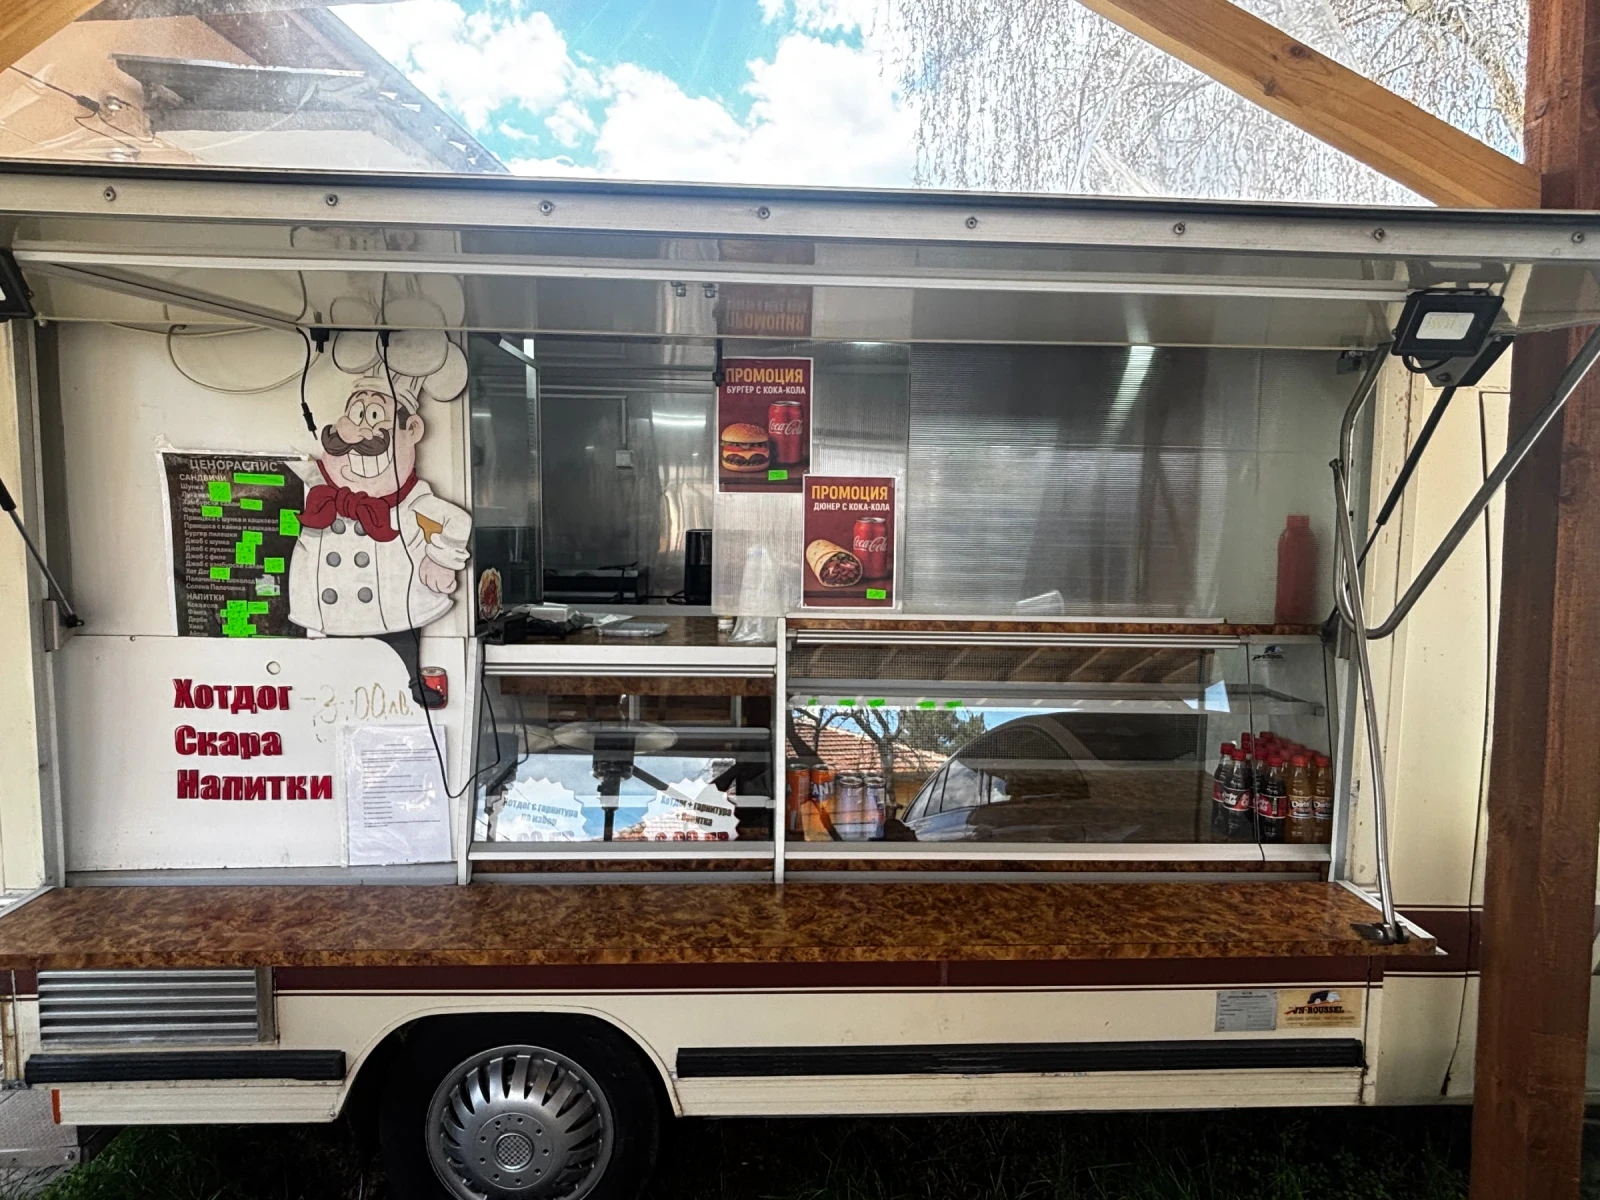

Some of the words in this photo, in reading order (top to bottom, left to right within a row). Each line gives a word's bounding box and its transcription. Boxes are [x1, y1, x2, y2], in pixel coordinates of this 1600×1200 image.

[725, 367, 803, 385] ПРОМОЦИЯ
[727, 386, 754, 394] БУРГЕР
[756, 386, 761, 394] С
[763, 386, 806, 395] КОКА-КОЛА
[180, 473, 227, 482] САНДВИЧИ
[180, 483, 204, 491] Шунка
[811, 485, 888, 502] ПРОМОЦИЯ
[813, 502, 841, 511] ДЮНЕР
[842, 502, 848, 511] С
[849, 503, 890, 511] КОКА-КОЛА
[184, 530, 208, 538] Бургер
[186, 592, 225, 601] НАПИТКИ
[172, 678, 292, 714] Хотдог
[174, 724, 283, 759] Скара
[177, 769, 333, 801] Напитки
